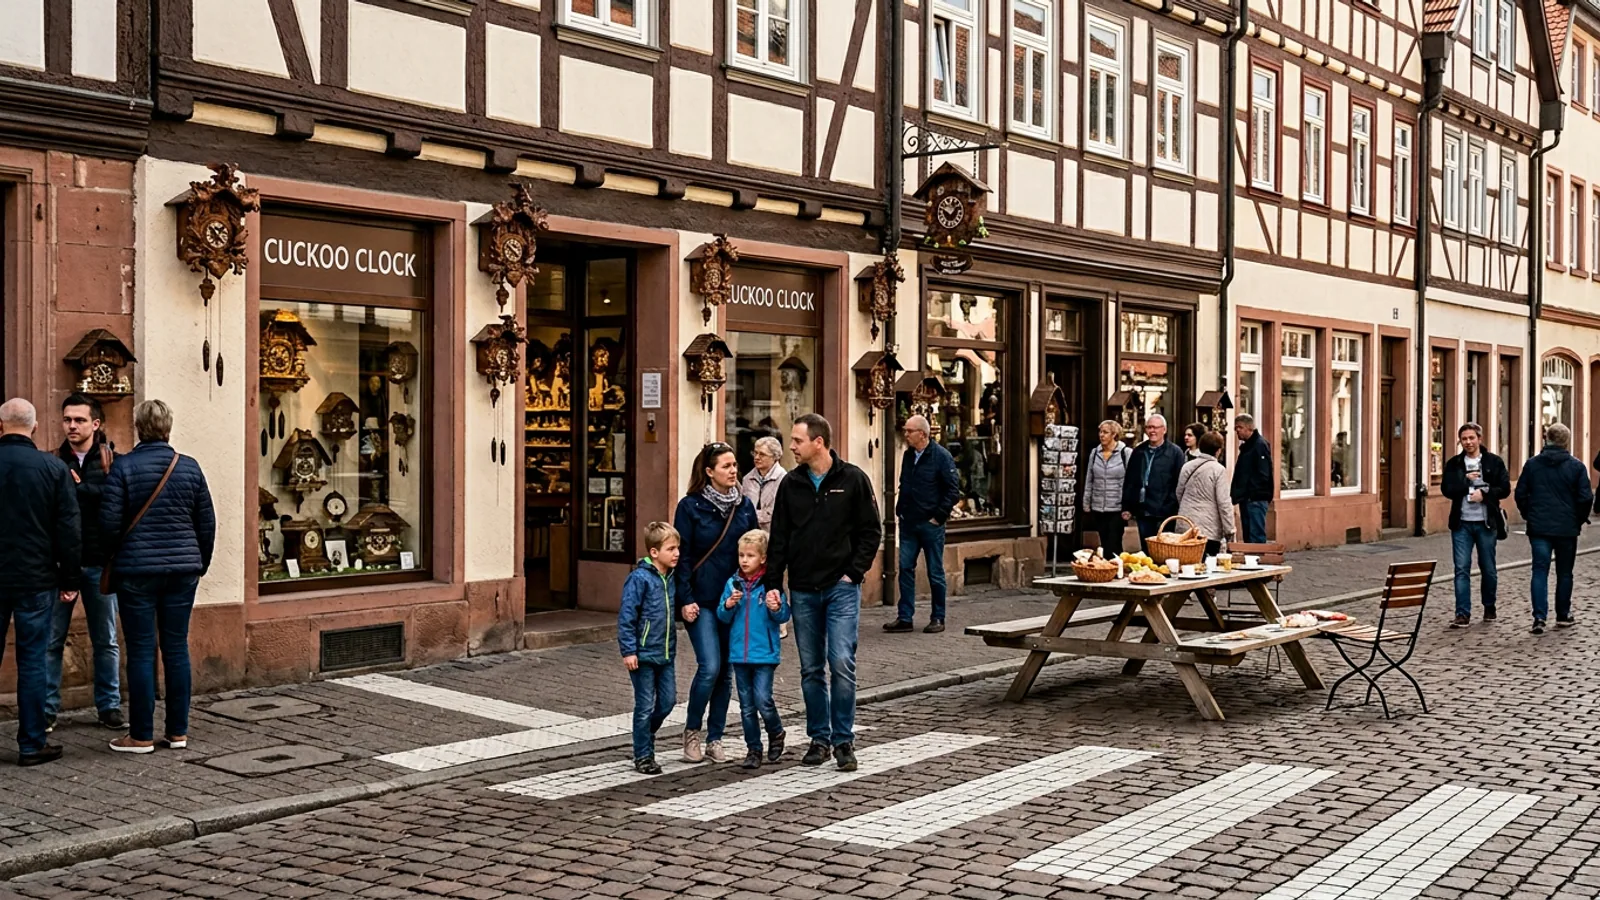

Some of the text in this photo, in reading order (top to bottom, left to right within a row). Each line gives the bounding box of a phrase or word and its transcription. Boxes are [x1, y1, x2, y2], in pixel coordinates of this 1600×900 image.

[264, 238, 417, 277] CUCKOO CLOCK
[727, 284, 815, 311] UCKOO CLOCK
